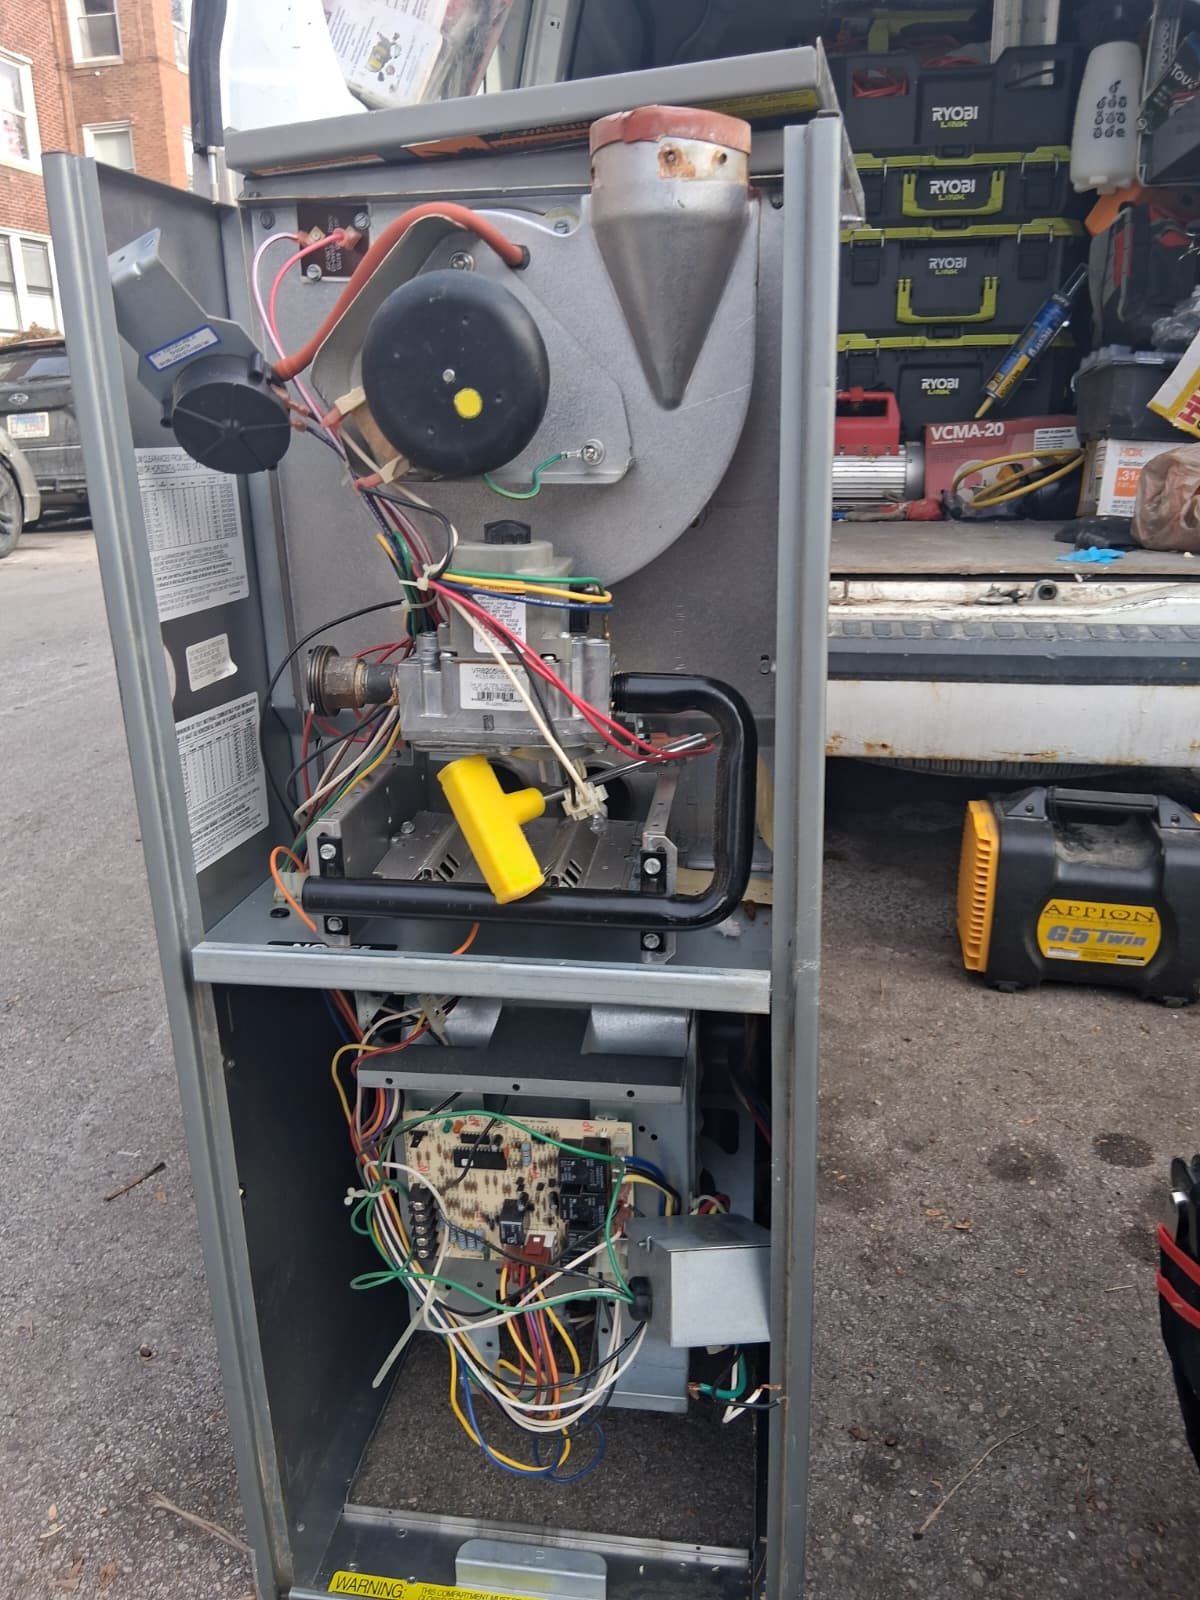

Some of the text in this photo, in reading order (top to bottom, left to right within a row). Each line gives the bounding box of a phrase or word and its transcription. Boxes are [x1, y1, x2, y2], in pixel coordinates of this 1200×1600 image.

[931, 106, 979, 121] RYOBI
[929, 179, 976, 194] RYOBI
[928, 257, 967, 269] RYOBI
[921, 377, 959, 389] RYOBI
[931, 422, 1005, 440] VCMA-20
[1044, 904, 1155, 922] APPION
[1046, 925, 1090, 944] G5
[335, 1575, 407, 1599] WARNING:
